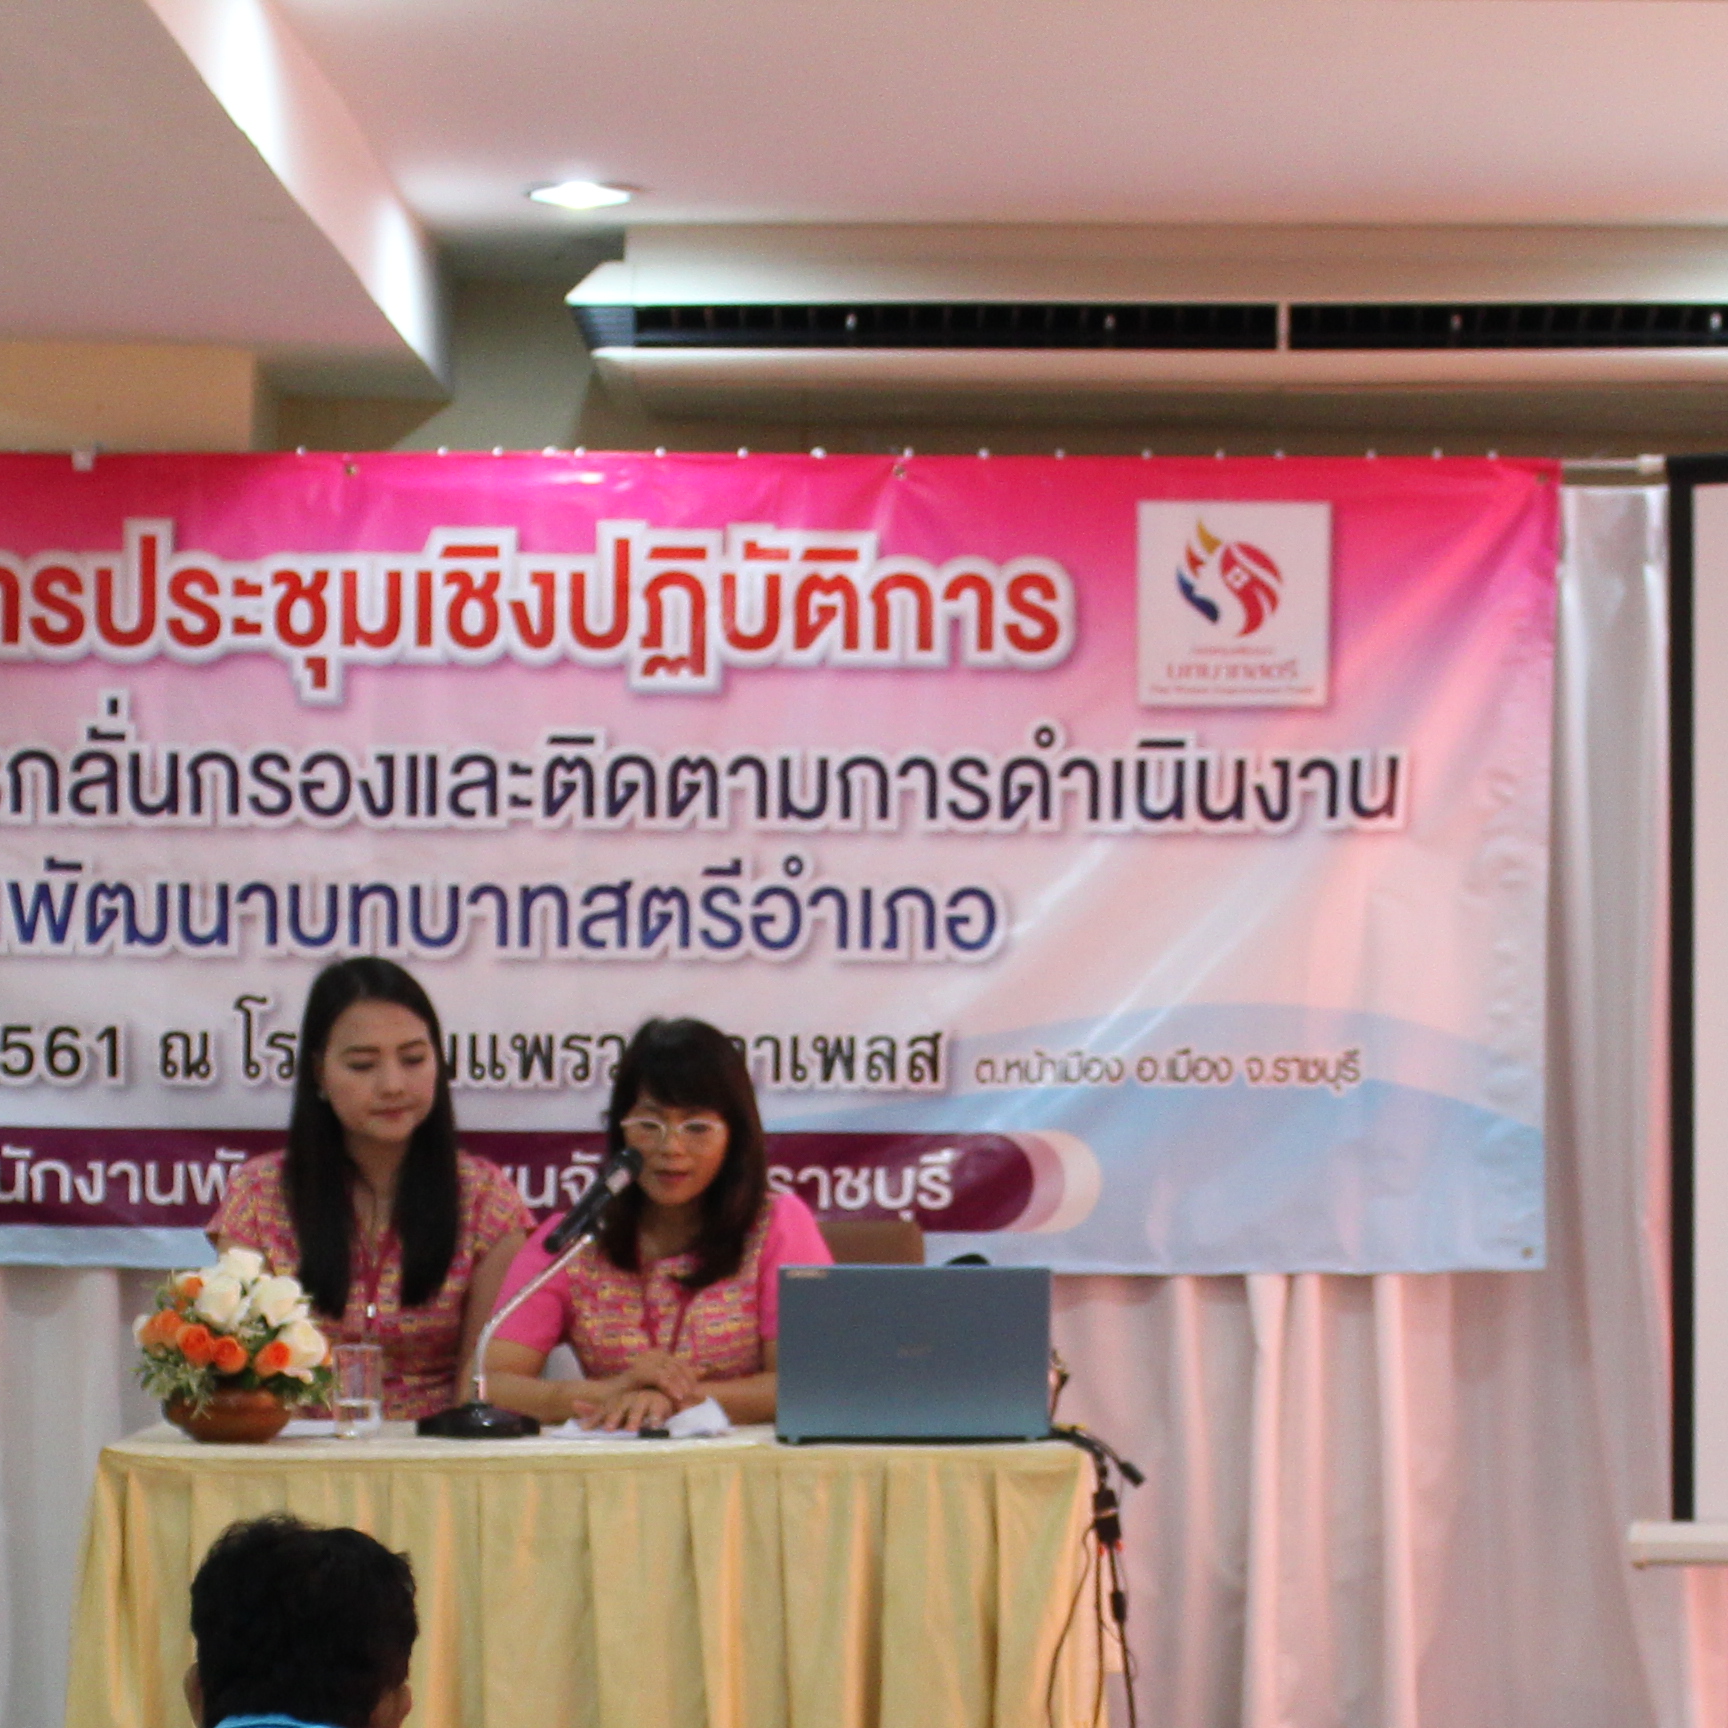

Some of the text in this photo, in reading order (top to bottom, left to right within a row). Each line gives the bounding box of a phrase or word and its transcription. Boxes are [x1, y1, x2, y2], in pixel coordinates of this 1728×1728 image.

[160, 1029, 211, 1079] ณ
[1137, 1048, 1234, 1083] อ.เมือง
[1245, 1048, 1361, 1092] จ.ราชบุรี
